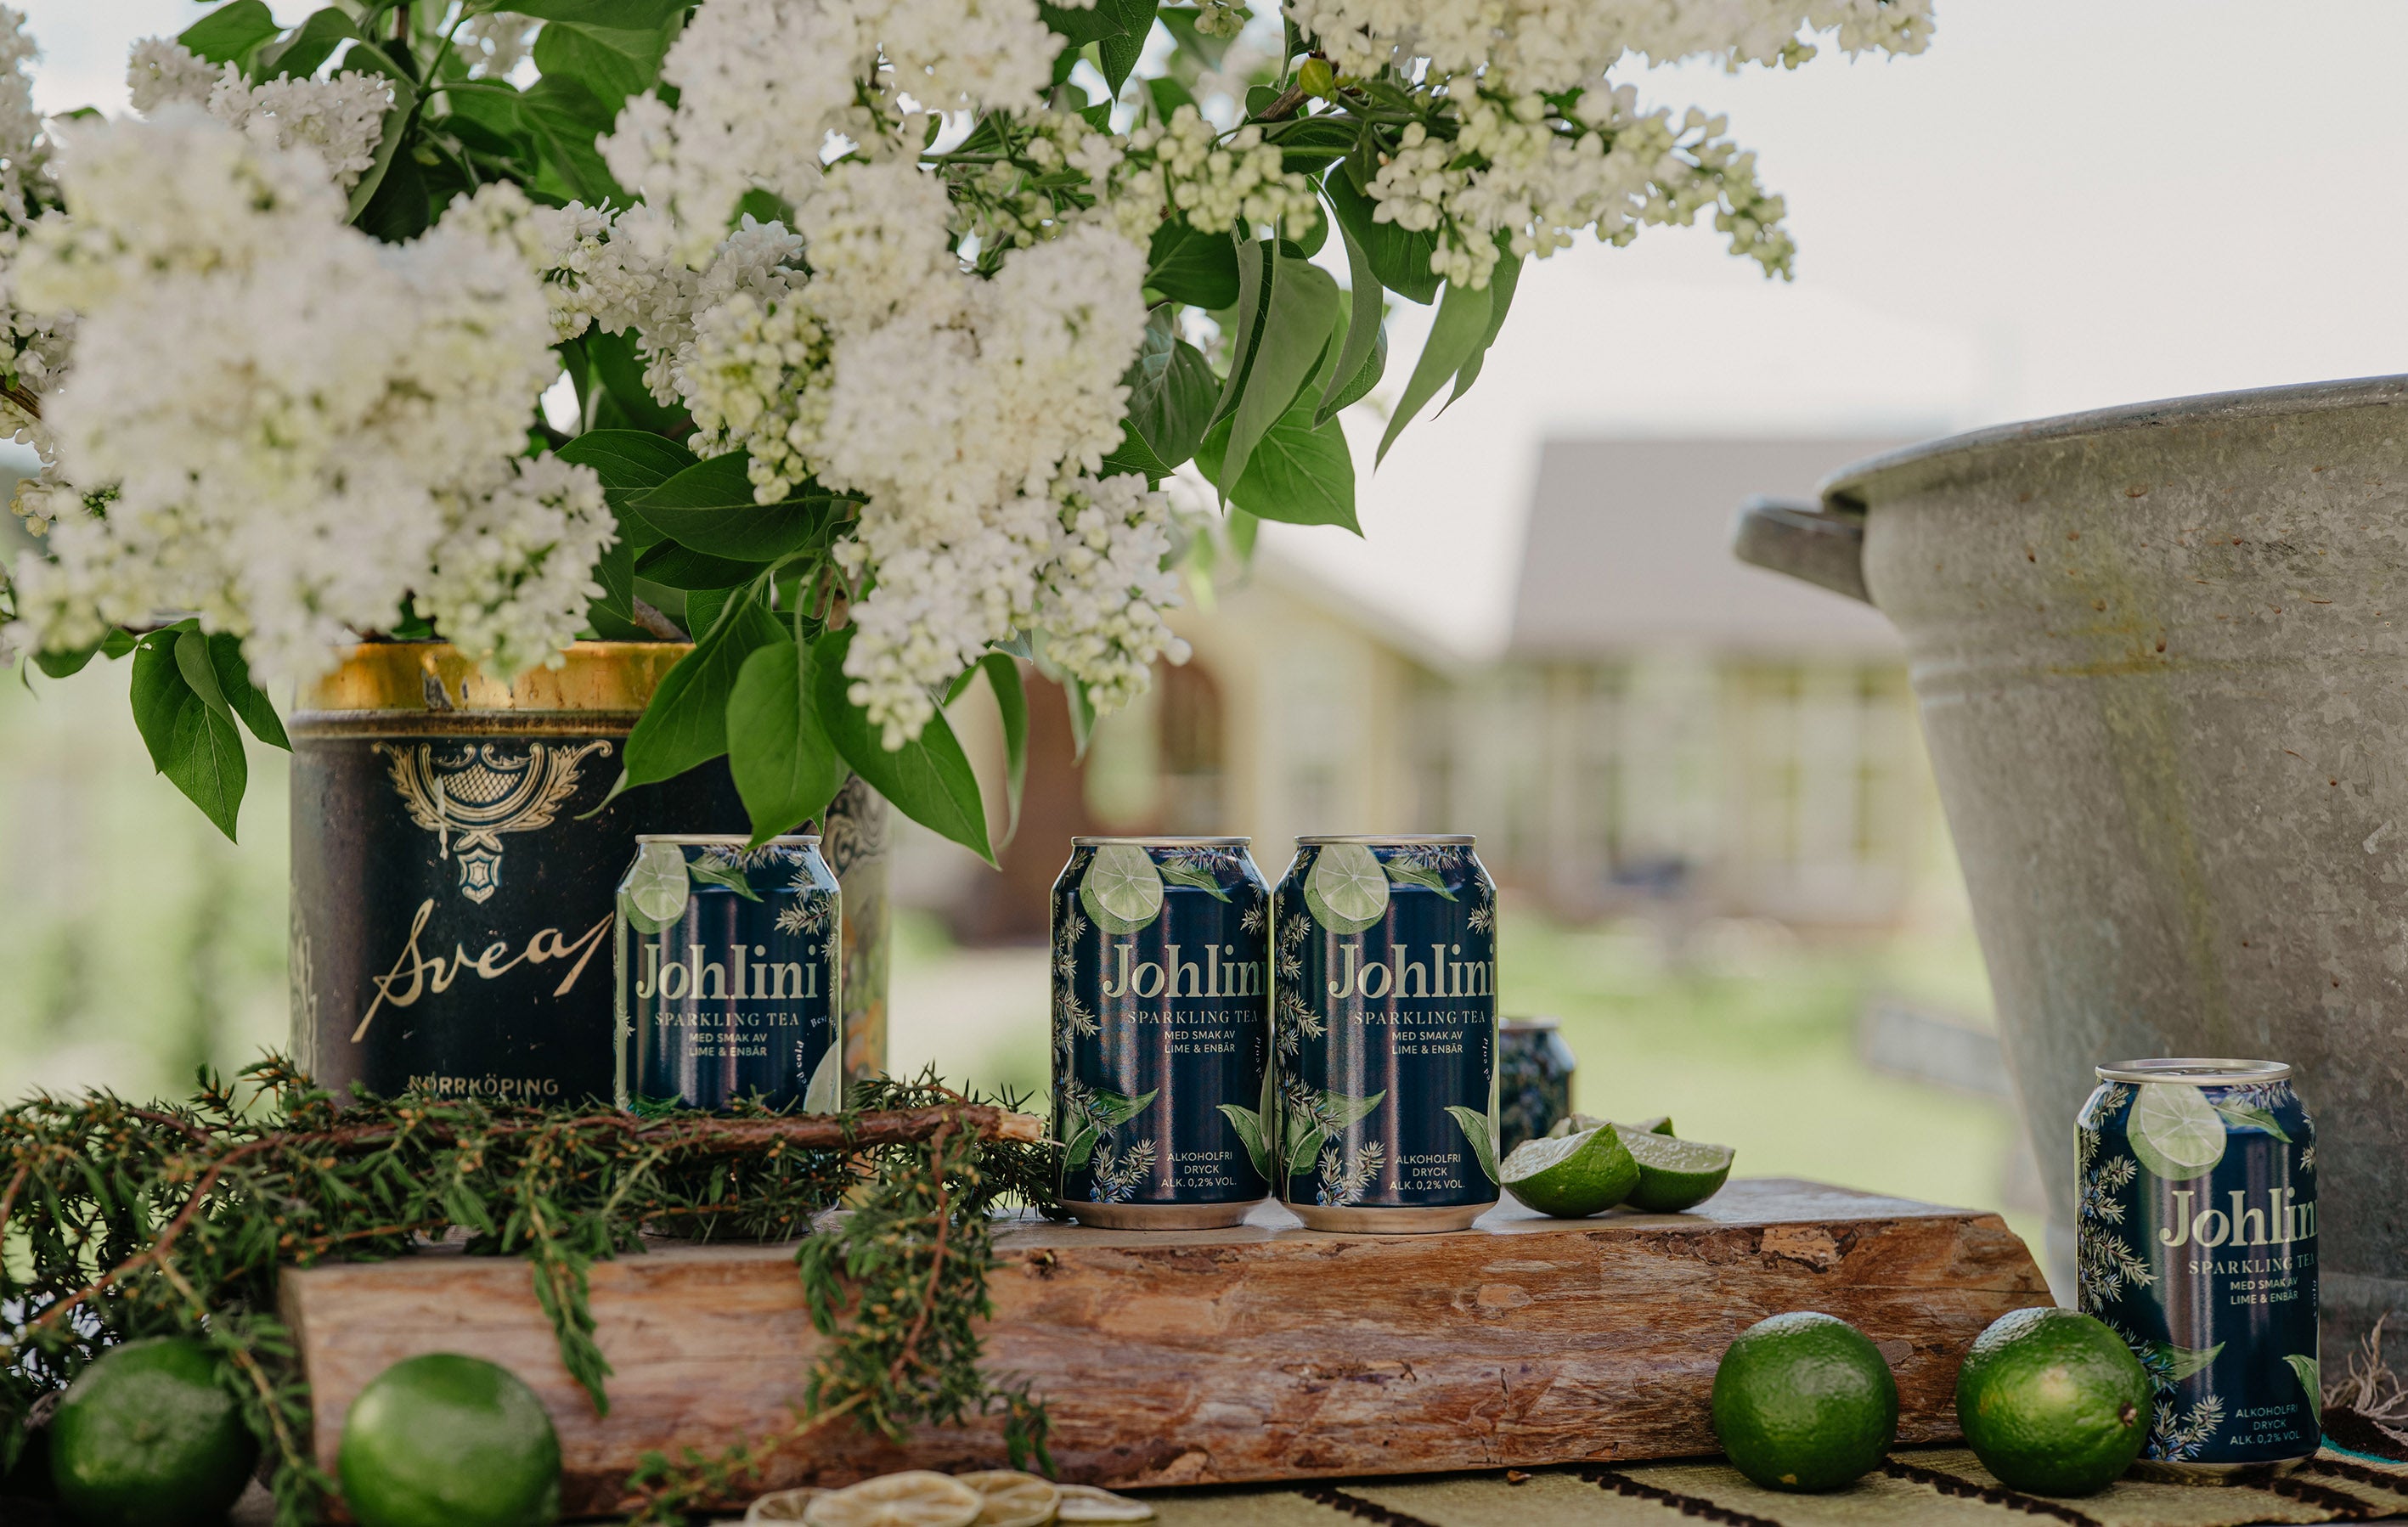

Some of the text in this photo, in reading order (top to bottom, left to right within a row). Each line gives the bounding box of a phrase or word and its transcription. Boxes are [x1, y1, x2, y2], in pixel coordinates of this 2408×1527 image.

[636, 944, 818, 1000] Johlini
[1328, 944, 1495, 999] Johlini
[655, 1012, 800, 1027] SPARKLING TEA
[1127, 1010, 1258, 1024] SPARKLING TEA
[1354, 1011, 1457, 1025] SPARKLING
[1462, 1011, 1486, 1024] TEA
[689, 1033, 768, 1043] MED SMAK AV
[1165, 1030, 1236, 1040] MED SMAK AV
[1392, 1031, 1463, 1041] MED SMAK AV
[689, 1045, 768, 1057] LIME & ENBÄR
[1165, 1042, 1236, 1054] LIME & ENBÄR
[1392, 1043, 1463, 1055] LIME & ENBÄR
[1166, 1151, 1232, 1162] ALKOHOLFRI
[1395, 1153, 1461, 1164] ALKOHOLFRI
[1184, 1164, 1220, 1175] DRYCK
[1413, 1167, 1448, 1177] DRYCK
[1161, 1176, 1237, 1189] ALK. 0,2% VOL.
[1389, 1179, 1465, 1192] ALK. 0,2% VOL.
[2159, 1186, 2318, 1248] Johlin
[2188, 1252, 2315, 1275] SPARKLING TEA
[2230, 1276, 2299, 1291] MED SMAK AV
[2230, 1288, 2298, 1305] LIME & ENBÄR
[2236, 1404, 2298, 1418] ALKOHOLFRI
[2253, 1419, 2287, 1431] DRYCK
[2230, 1435, 2255, 1445] ALK.
